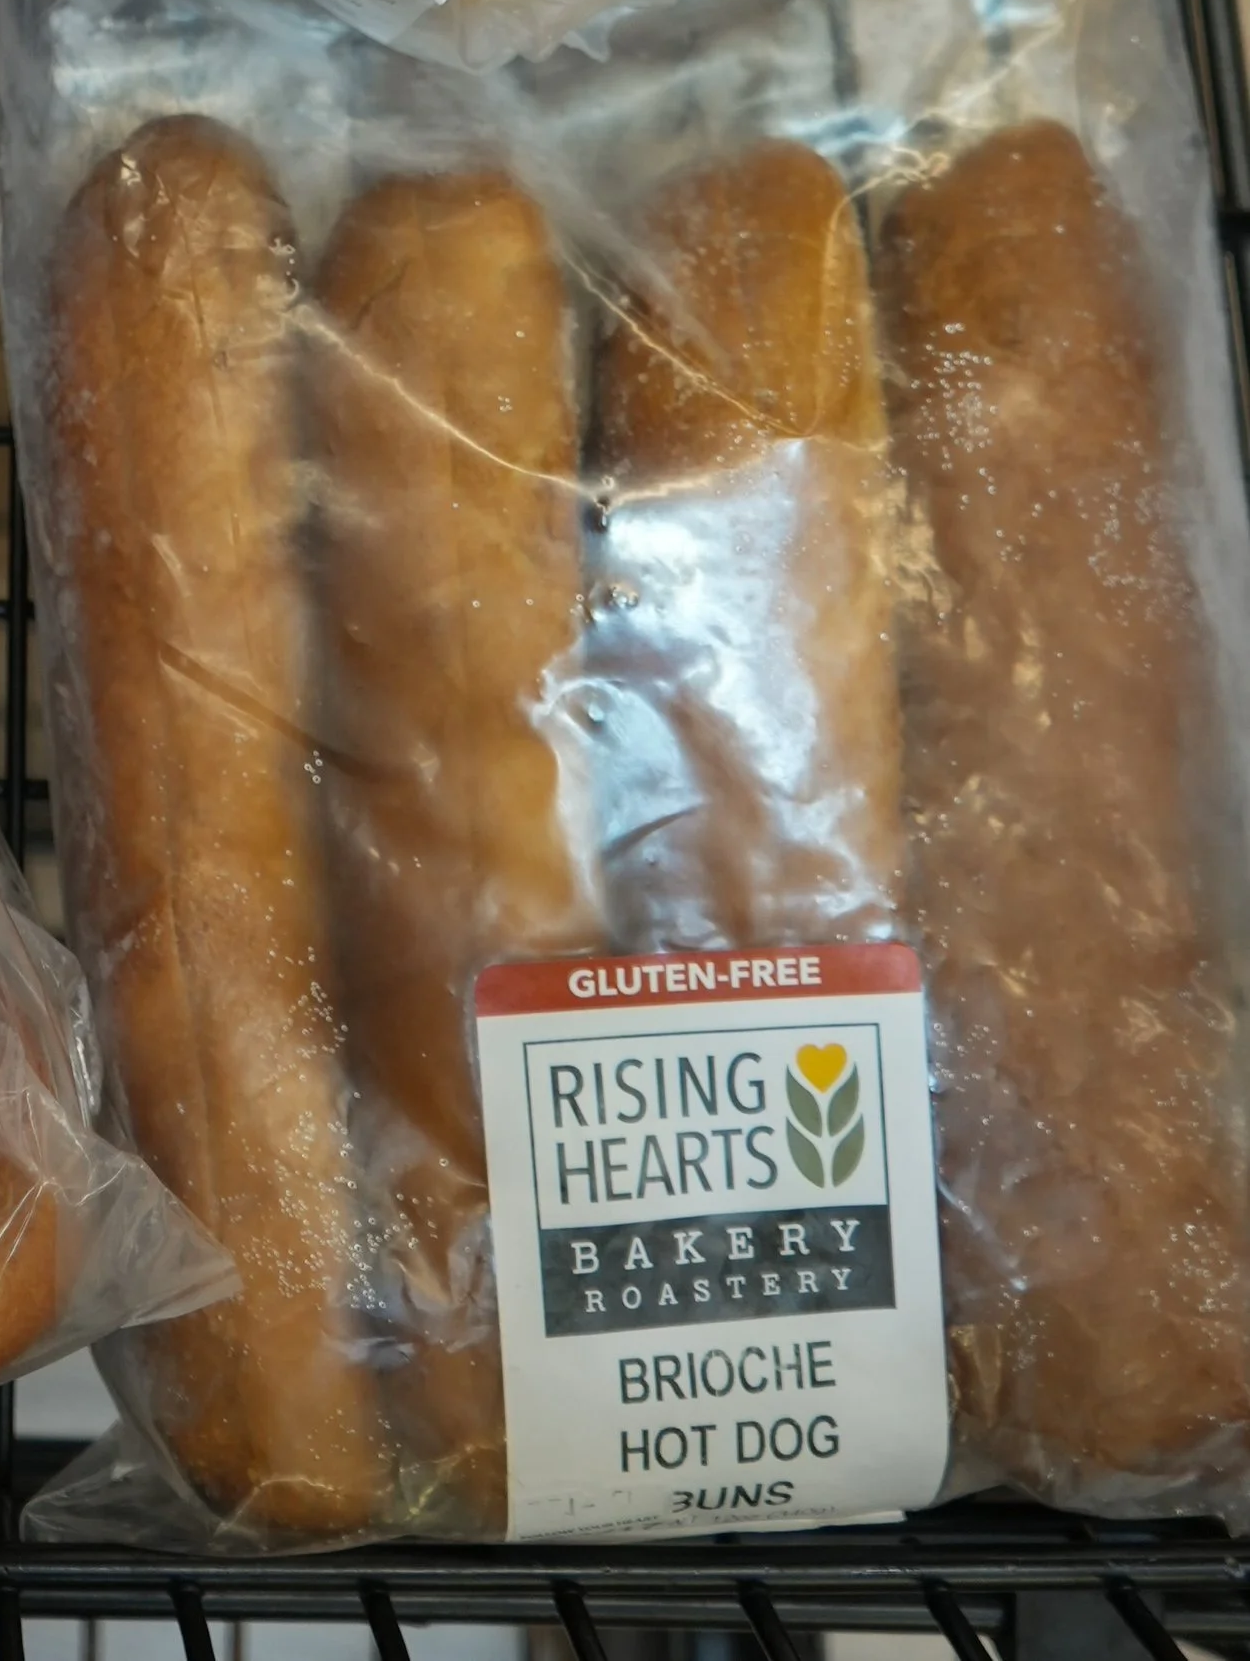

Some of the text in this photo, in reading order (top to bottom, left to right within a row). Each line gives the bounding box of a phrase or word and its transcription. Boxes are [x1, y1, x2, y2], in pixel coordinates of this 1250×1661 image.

[568, 956, 822, 998] GLUTEN-FREE
[549, 1052, 766, 1128] RISING
[556, 1126, 778, 1205] HEARTS
[571, 1219, 859, 1275] BAKERY
[585, 1268, 852, 1314] ROASTERY
[619, 1340, 836, 1404] BRIOCHE
[620, 1415, 840, 1473] HOT DOG
